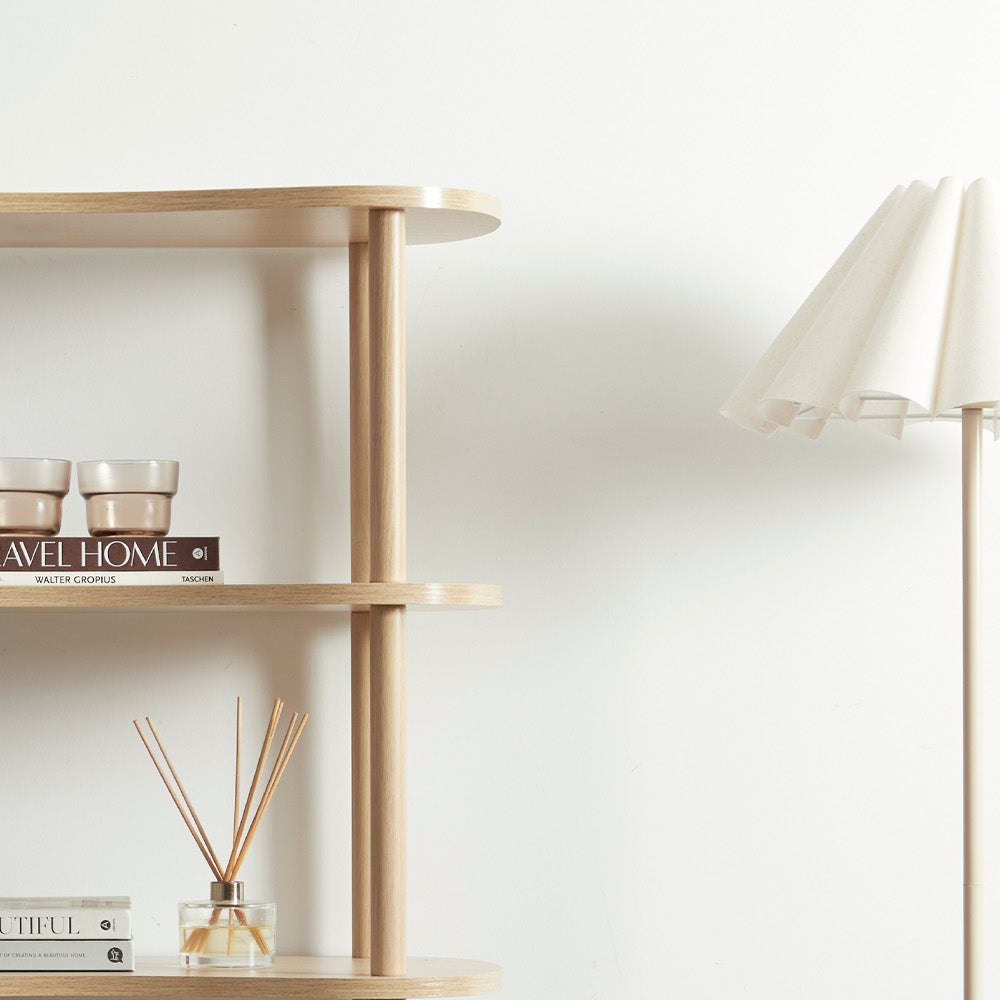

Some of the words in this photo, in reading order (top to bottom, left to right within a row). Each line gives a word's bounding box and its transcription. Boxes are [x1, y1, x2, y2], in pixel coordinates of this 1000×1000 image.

[81, 540, 178, 567] HOME
[35, 576, 71, 584] WALTER
[74, 576, 116, 584] GROPIUS
